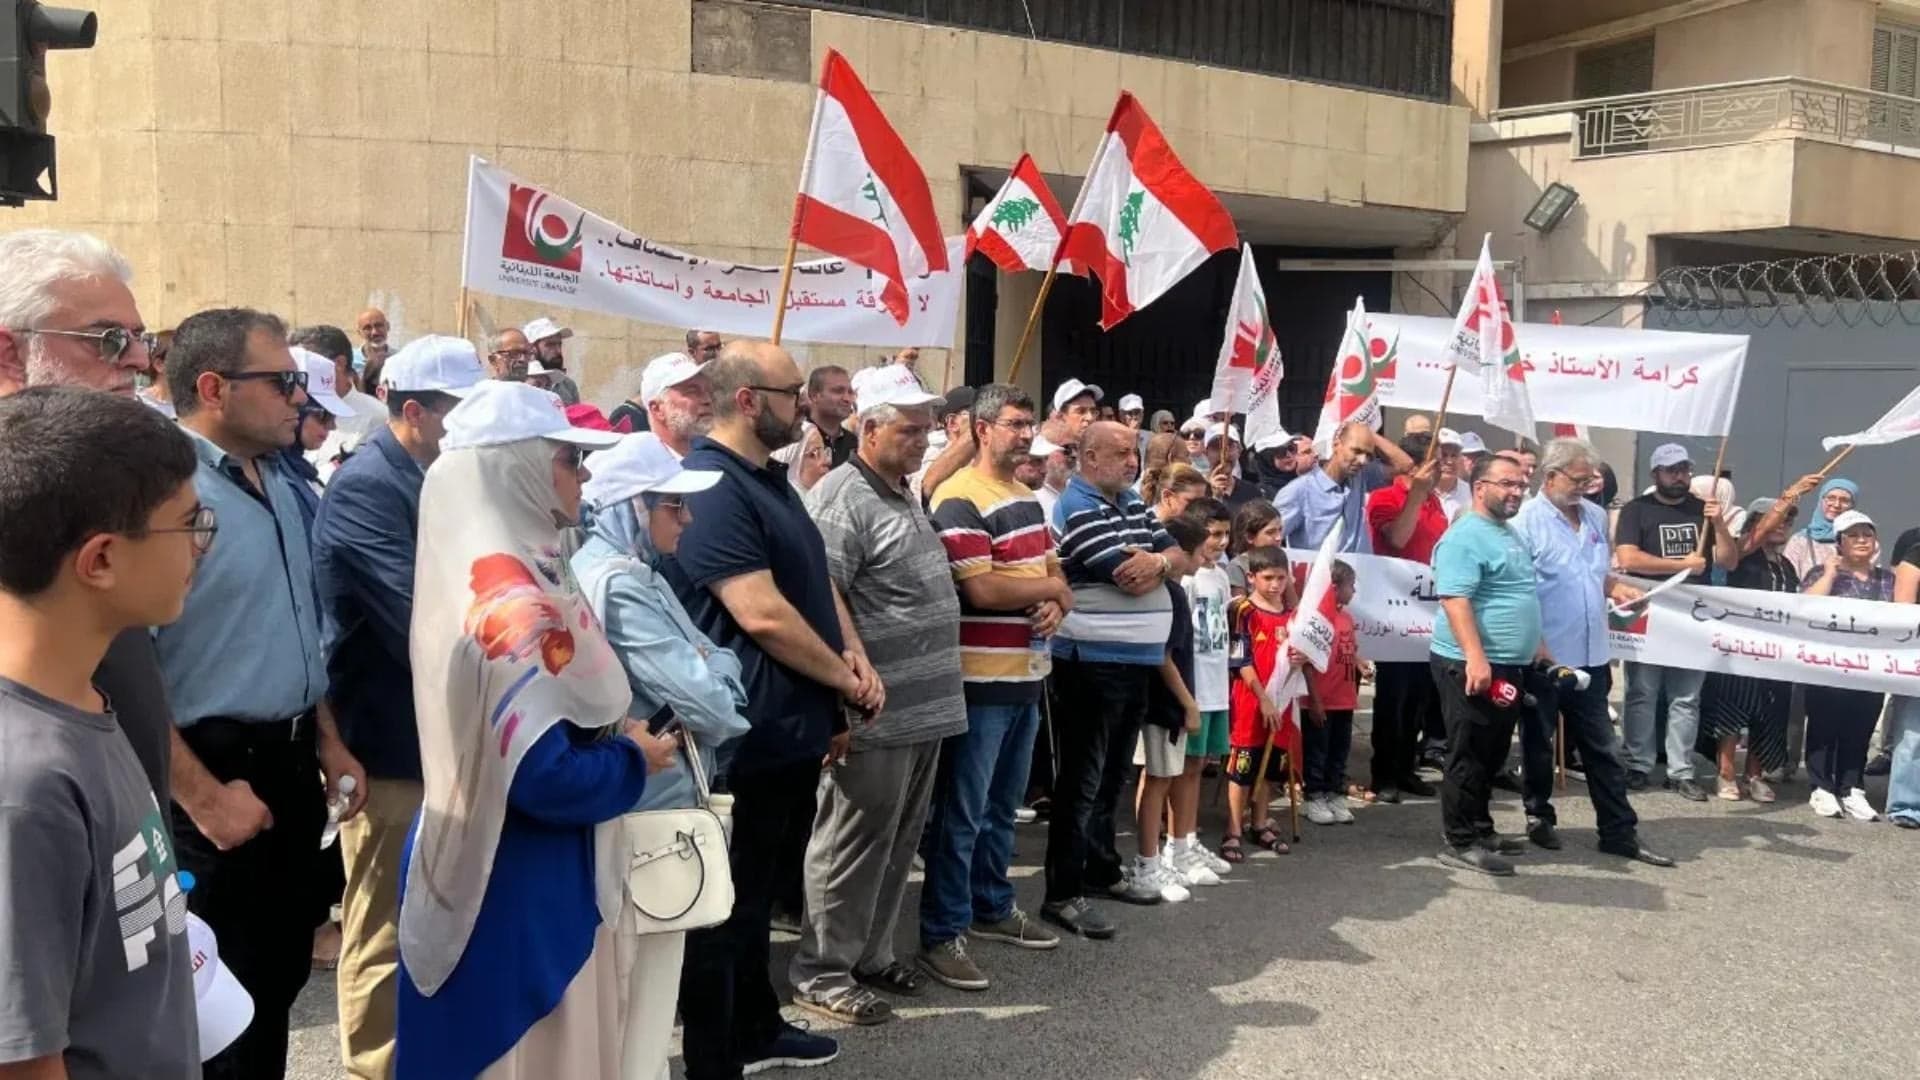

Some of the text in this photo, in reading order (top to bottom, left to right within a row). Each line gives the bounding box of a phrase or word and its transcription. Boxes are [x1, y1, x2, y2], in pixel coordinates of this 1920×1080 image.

[499, 259, 580, 285] الجامعة اللبنانية
[703, 279, 771, 307] الجامعة
[785, 290, 846, 312] مستقبل
[917, 293, 930, 311] لا
[1548, 351, 1621, 380] الأستاذ
[1632, 355, 1700, 390] كرامة
[1690, 597, 1920, 643] ار ملف التفرغ
[1710, 631, 1920, 677] قاذ للجامعة اللبنانية
